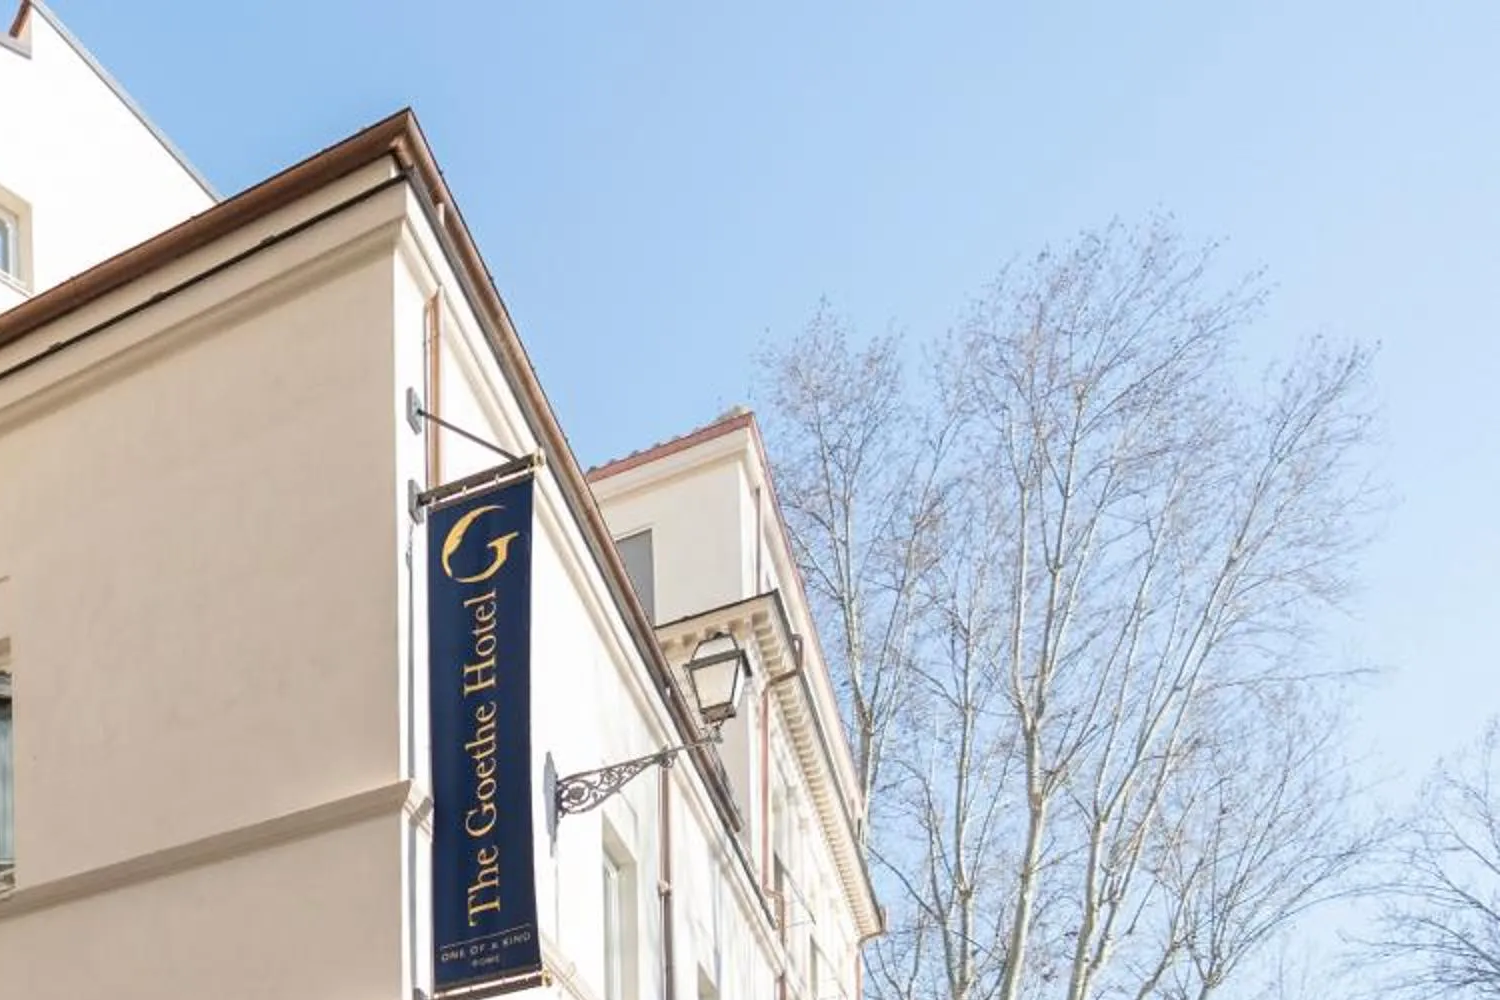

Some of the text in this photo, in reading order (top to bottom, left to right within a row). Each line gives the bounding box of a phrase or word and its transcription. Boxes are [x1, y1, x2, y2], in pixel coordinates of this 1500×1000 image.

[441, 504, 520, 584] G
[463, 587, 501, 928] The Goethe Hotel
[440, 931, 532, 963] ONE OF A KIND
